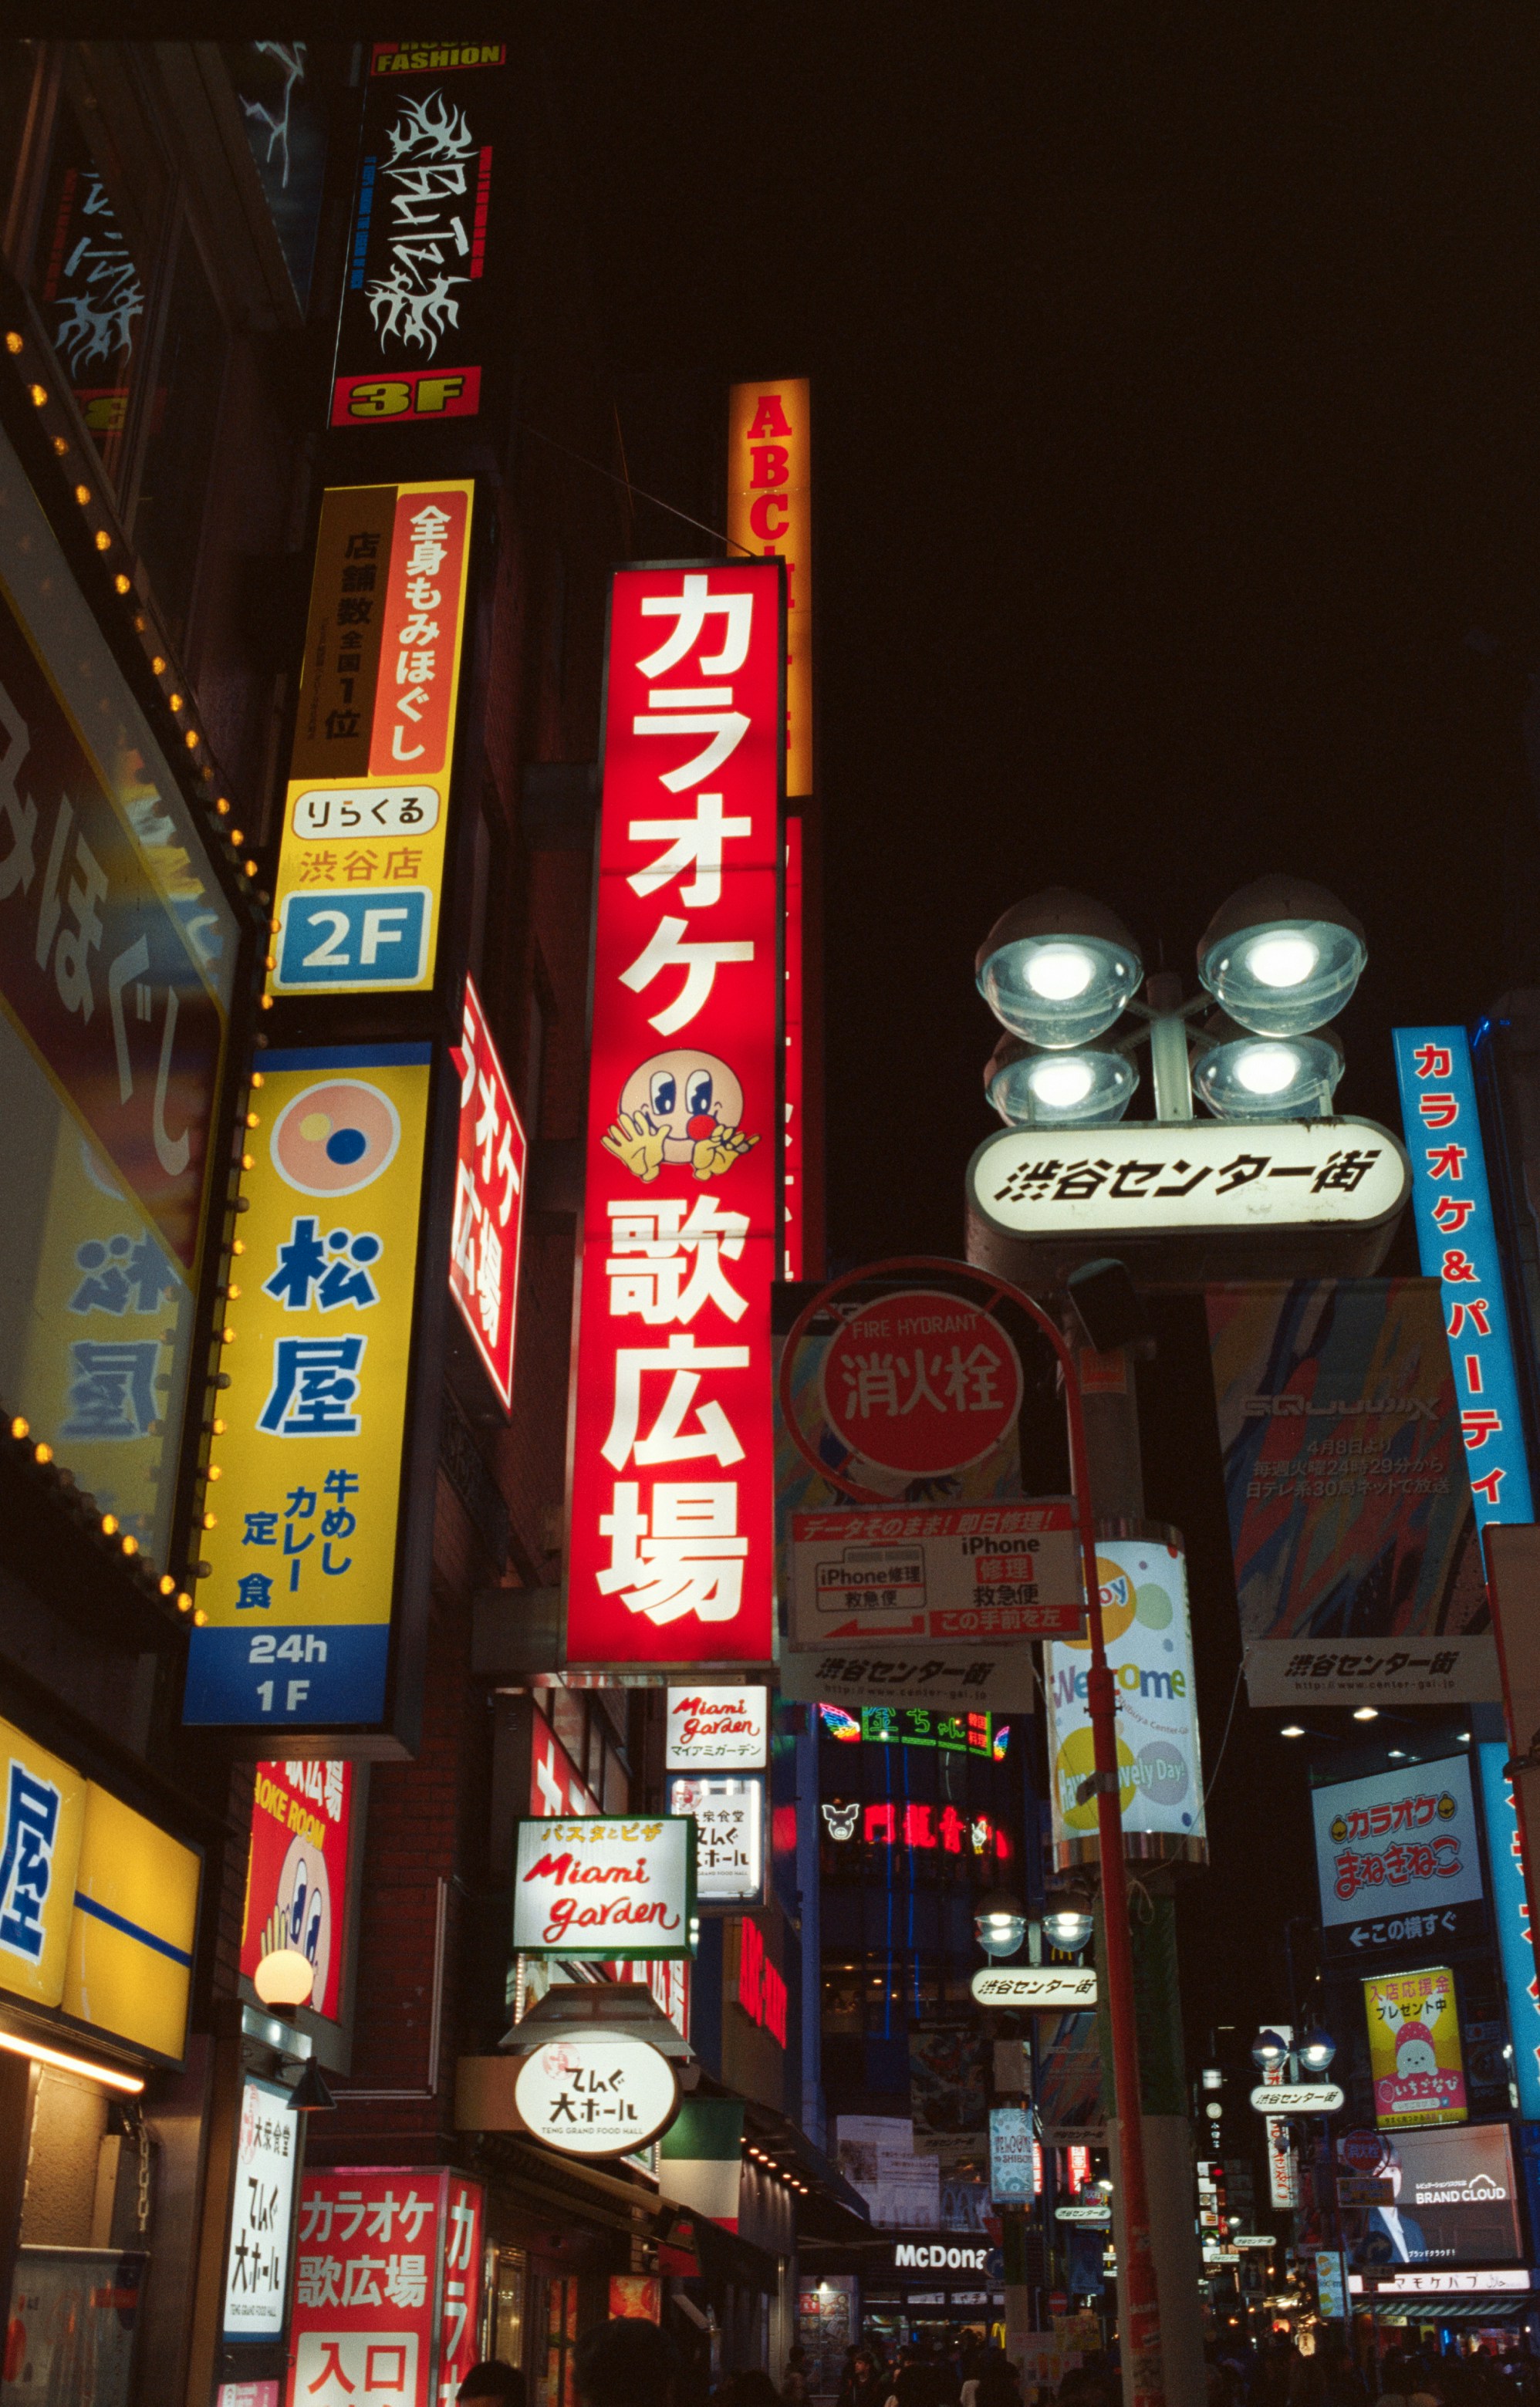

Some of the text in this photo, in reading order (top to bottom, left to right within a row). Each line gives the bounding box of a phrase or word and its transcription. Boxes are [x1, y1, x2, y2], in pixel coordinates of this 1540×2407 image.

[377, 46, 500, 72] FASHION
[350, 376, 463, 417] 3F
[390, 505, 451, 762] 全身もみほぐし
[307, 798, 424, 829] りらくる
[617, 574, 754, 1036] カラオケ
[298, 849, 424, 883] 渋谷店
[302, 907, 409, 967] 2F
[992, 1149, 1383, 1203] 渋谷センター街
[1414, 1042, 1507, 1524] カラオケ&パーティ
[257, 1215, 383, 1436] 松屋
[853, 1314, 980, 1340] FIRE HYDRANT
[839, 1343, 1005, 1420] 消火栓
[596, 1194, 751, 1626] 歌広場
[1307, 1438, 1391, 1457] 4月8日より
[320, 1469, 360, 1575] 牛めし
[802, 1513, 1052, 1538] データそのまま! 即日修理!
[282, 1486, 317, 1592] カレー
[961, 1531, 1040, 1555] iPhone
[235, 1511, 279, 1609] 定食
[981, 1557, 1028, 1580] 修理
[820, 1566, 921, 1585] iPhone修理
[845, 1590, 898, 1607] 救急便
[974, 1585, 1038, 1607] 救急便
[941, 1610, 1061, 1633] この手前を左
[249, 1635, 328, 1663] 24h
[815, 1658, 995, 1685] 渋谷センター街
[1285, 1651, 1461, 1677] 渋谷センター街
[256, 1682, 310, 1711] 1F
[673, 1697, 747, 1715] Miami
[680, 1717, 761, 1744] garden
[670, 1744, 762, 1757] マイアミガーデン
[287, 1800, 326, 1851] ROOM
[542, 1823, 664, 1842] パスタとピザ
[1347, 1794, 1438, 1842] カラオケ
[523, 1852, 650, 1886] Miami
[1334, 1835, 1463, 1900] まねきねこ
[543, 1897, 680, 1943] garden
[1371, 1911, 1456, 1941] この横すぐ
[978, 1979, 1096, 1995] 渋谷センター街
[1369, 1975, 1450, 2003] 入店応援金
[1376, 1998, 1446, 2020] プレゼント中
[566, 2068, 625, 2092] てんぐ
[1395, 2076, 1457, 2095] いちごなび
[549, 2093, 638, 2122] 大ホール
[1256, 2091, 1338, 2105] 渋谷センター街
[248, 2176, 279, 2231] てんぐ
[1416, 2187, 1505, 2205] BRAND CLOUD
[299, 2191, 434, 2242] カラオケ
[231, 2228, 279, 2293] 大ホール
[895, 2244, 995, 2270] McDona
[298, 2255, 427, 2308] 歌広場
[307, 2342, 407, 2394] 入口
